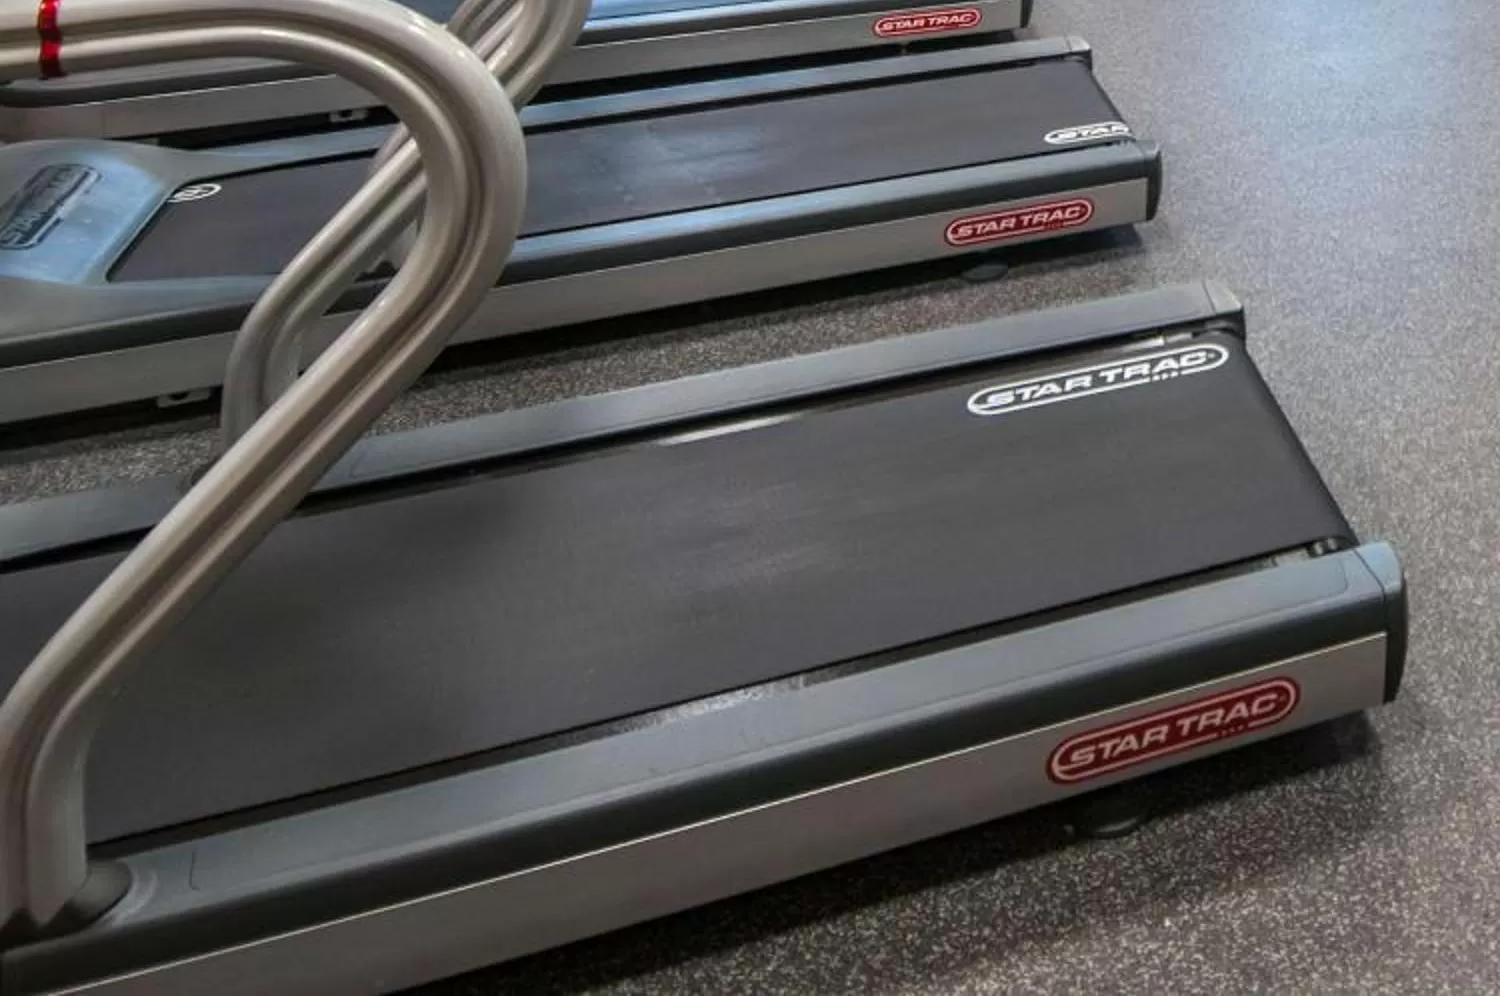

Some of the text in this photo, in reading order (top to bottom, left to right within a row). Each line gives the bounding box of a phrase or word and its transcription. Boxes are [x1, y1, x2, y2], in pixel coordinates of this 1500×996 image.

[881, 12, 974, 31] STAR TRAC
[956, 205, 1081, 238] STAR TRAC
[986, 350, 1207, 406] STAR TRAC
[1069, 693, 1279, 768] STAR TRAC
